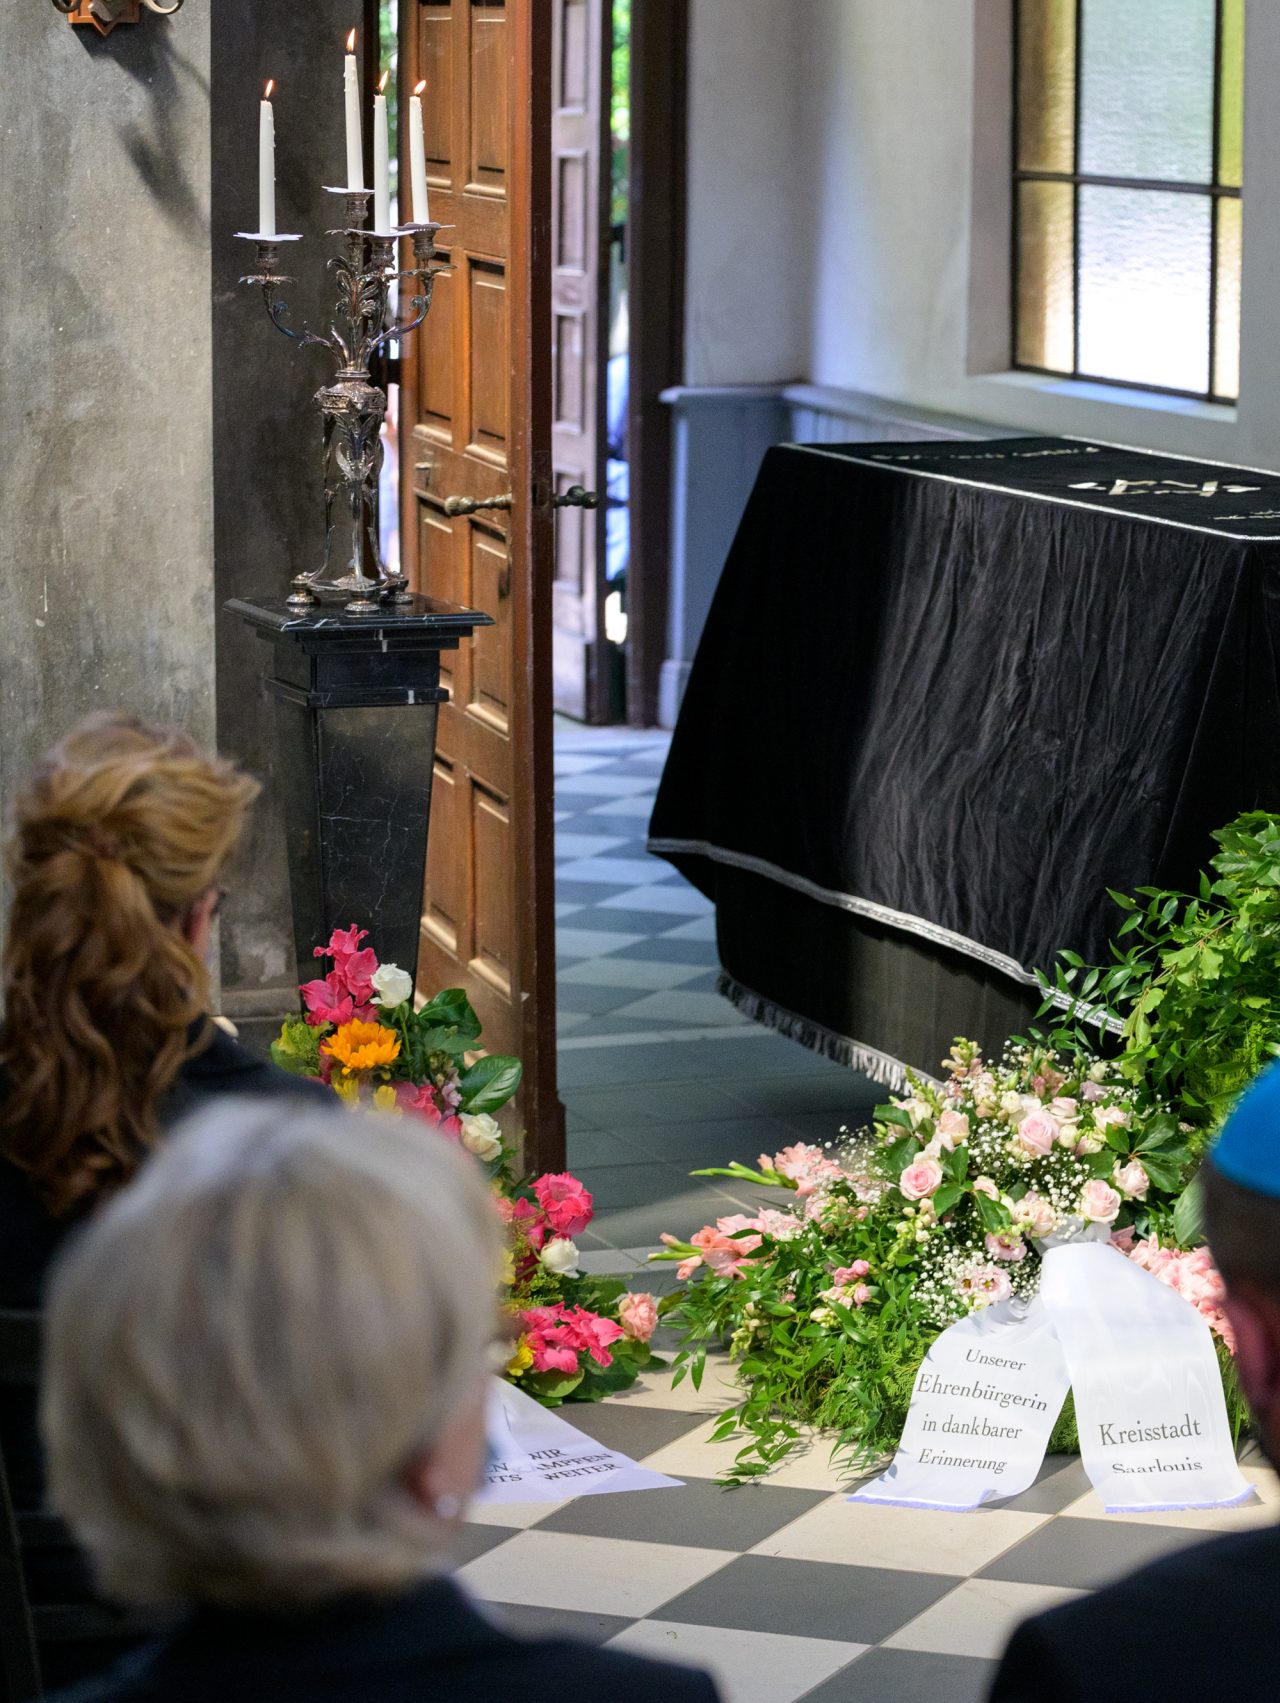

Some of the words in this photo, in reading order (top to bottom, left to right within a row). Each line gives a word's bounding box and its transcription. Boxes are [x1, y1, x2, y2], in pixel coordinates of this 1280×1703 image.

[966, 1348, 1027, 1371] Unserer
[917, 1373, 1048, 1412] Ehrenbürgerin
[922, 1413, 938, 1433] in
[942, 1414, 1023, 1439] dankbarer
[1099, 1413, 1202, 1446] Kreisstadt
[918, 1448, 1008, 1475] Erinnerung
[1112, 1456, 1203, 1474] Saarlouis
